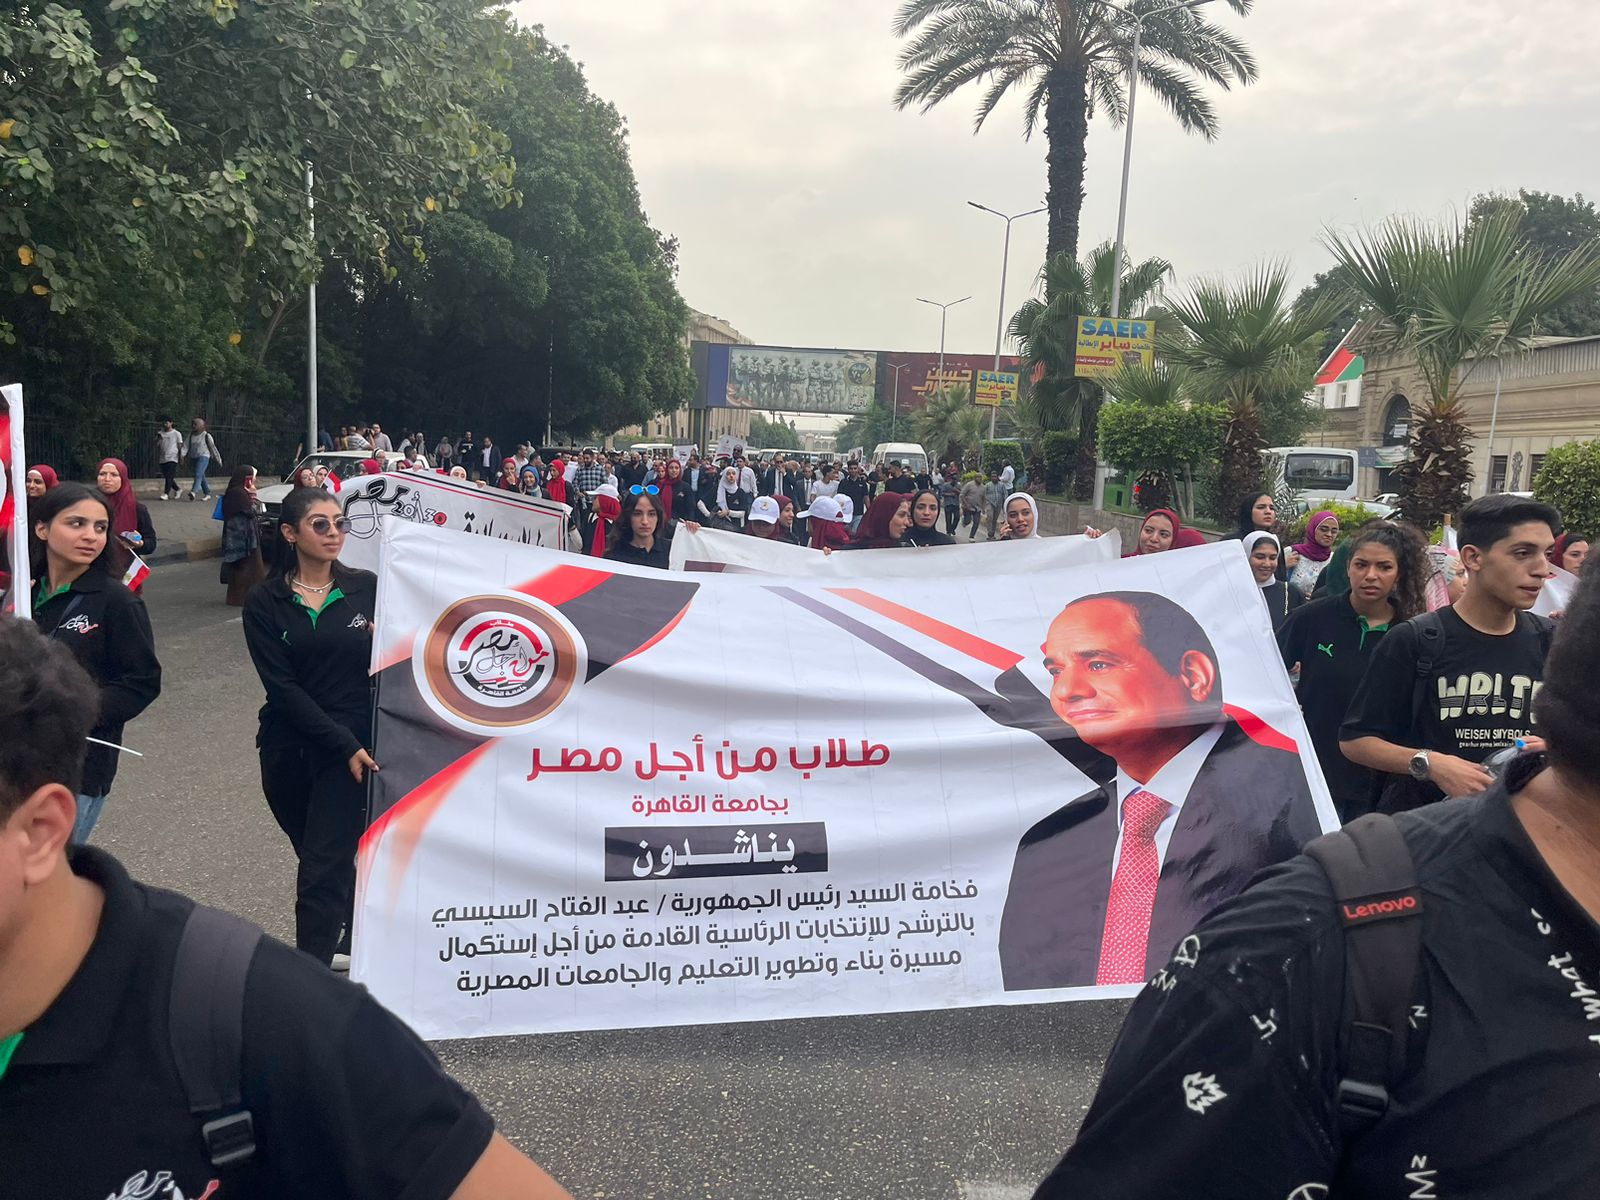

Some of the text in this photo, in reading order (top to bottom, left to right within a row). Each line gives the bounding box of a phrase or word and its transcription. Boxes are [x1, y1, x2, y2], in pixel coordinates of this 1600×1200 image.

[1081, 319, 1147, 339] SAER
[1100, 337, 1131, 352] ساير
[980, 372, 1015, 384] SAER
[1438, 672, 1544, 724] WRLT
[1455, 728, 1491, 740] WEISEN
[526, 733, 891, 782] طلاب من أجل مصر
[631, 793, 789, 817] بجامعة القاهرة
[631, 828, 799, 878] يناشدون
[670, 888, 782, 917] الجمهورية
[786, 883, 841, 911] رئيس
[846, 882, 906, 909] السيد
[911, 879, 979, 901] فخامة
[431, 898, 538, 929] السيسي
[543, 895, 607, 923] الفتاح
[612, 897, 650, 920] عبد
[1343, 896, 1417, 920] Lenovo
[438, 909, 976, 962] بالترشح للإنتخابات الرئاسية القادمة من أجل إستكمال
[456, 948, 963, 998] مسيرة بناء وتطوير التعليم والجامعات المصرية
